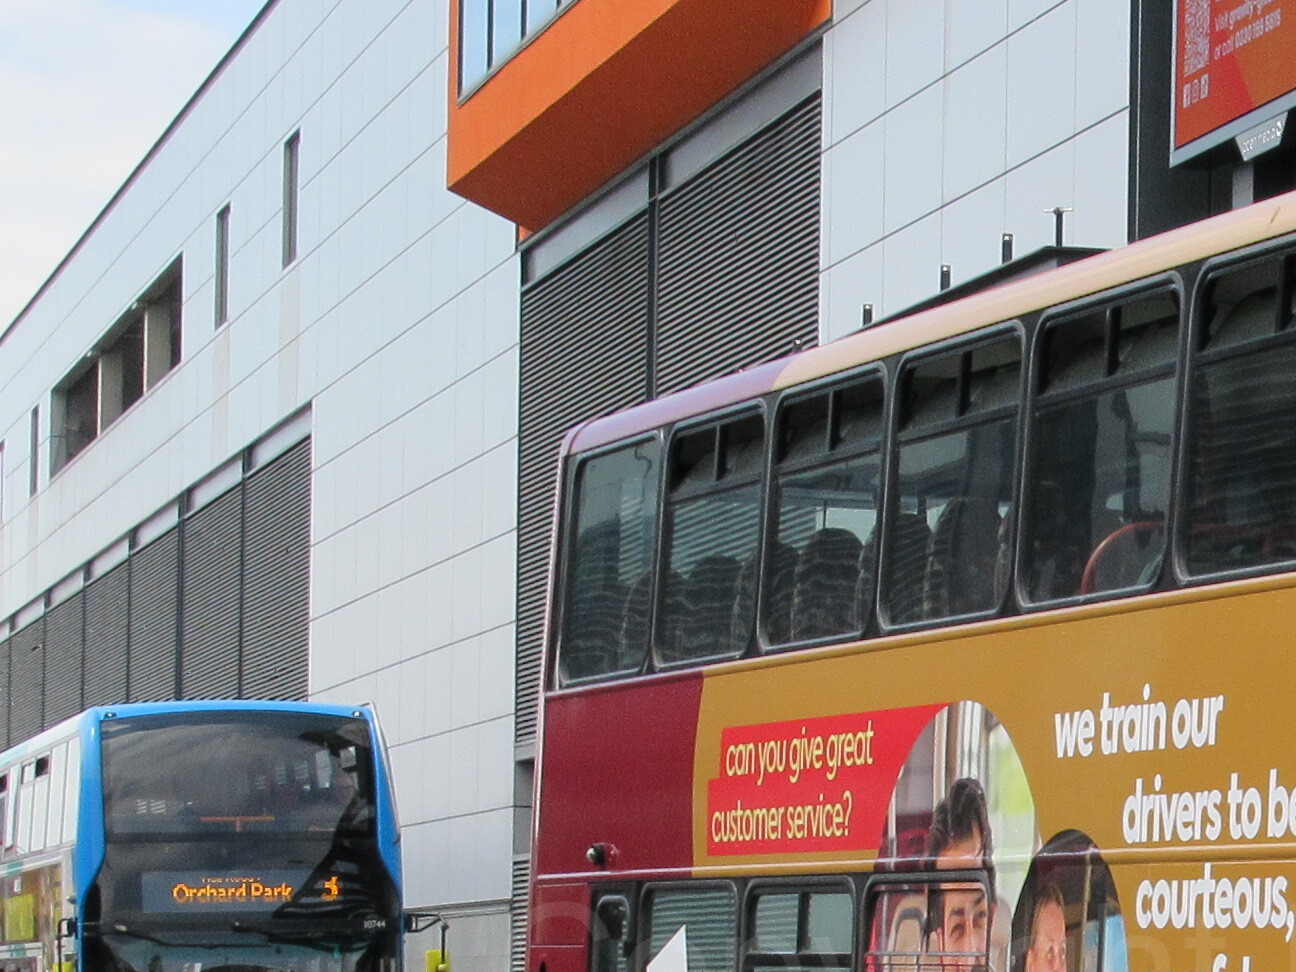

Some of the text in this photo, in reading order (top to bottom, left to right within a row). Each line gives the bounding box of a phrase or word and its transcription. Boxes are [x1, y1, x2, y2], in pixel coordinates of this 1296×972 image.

[1054, 682, 1226, 760] we train our
[725, 724, 875, 786] can you give great
[710, 792, 853, 844] customer service?
[1121, 774, 1225, 845] drivers
[1227, 772, 1261, 840] to
[171, 883, 247, 903] Orchard
[250, 882, 294, 903] Park
[1135, 861, 1295, 943] courteous,
